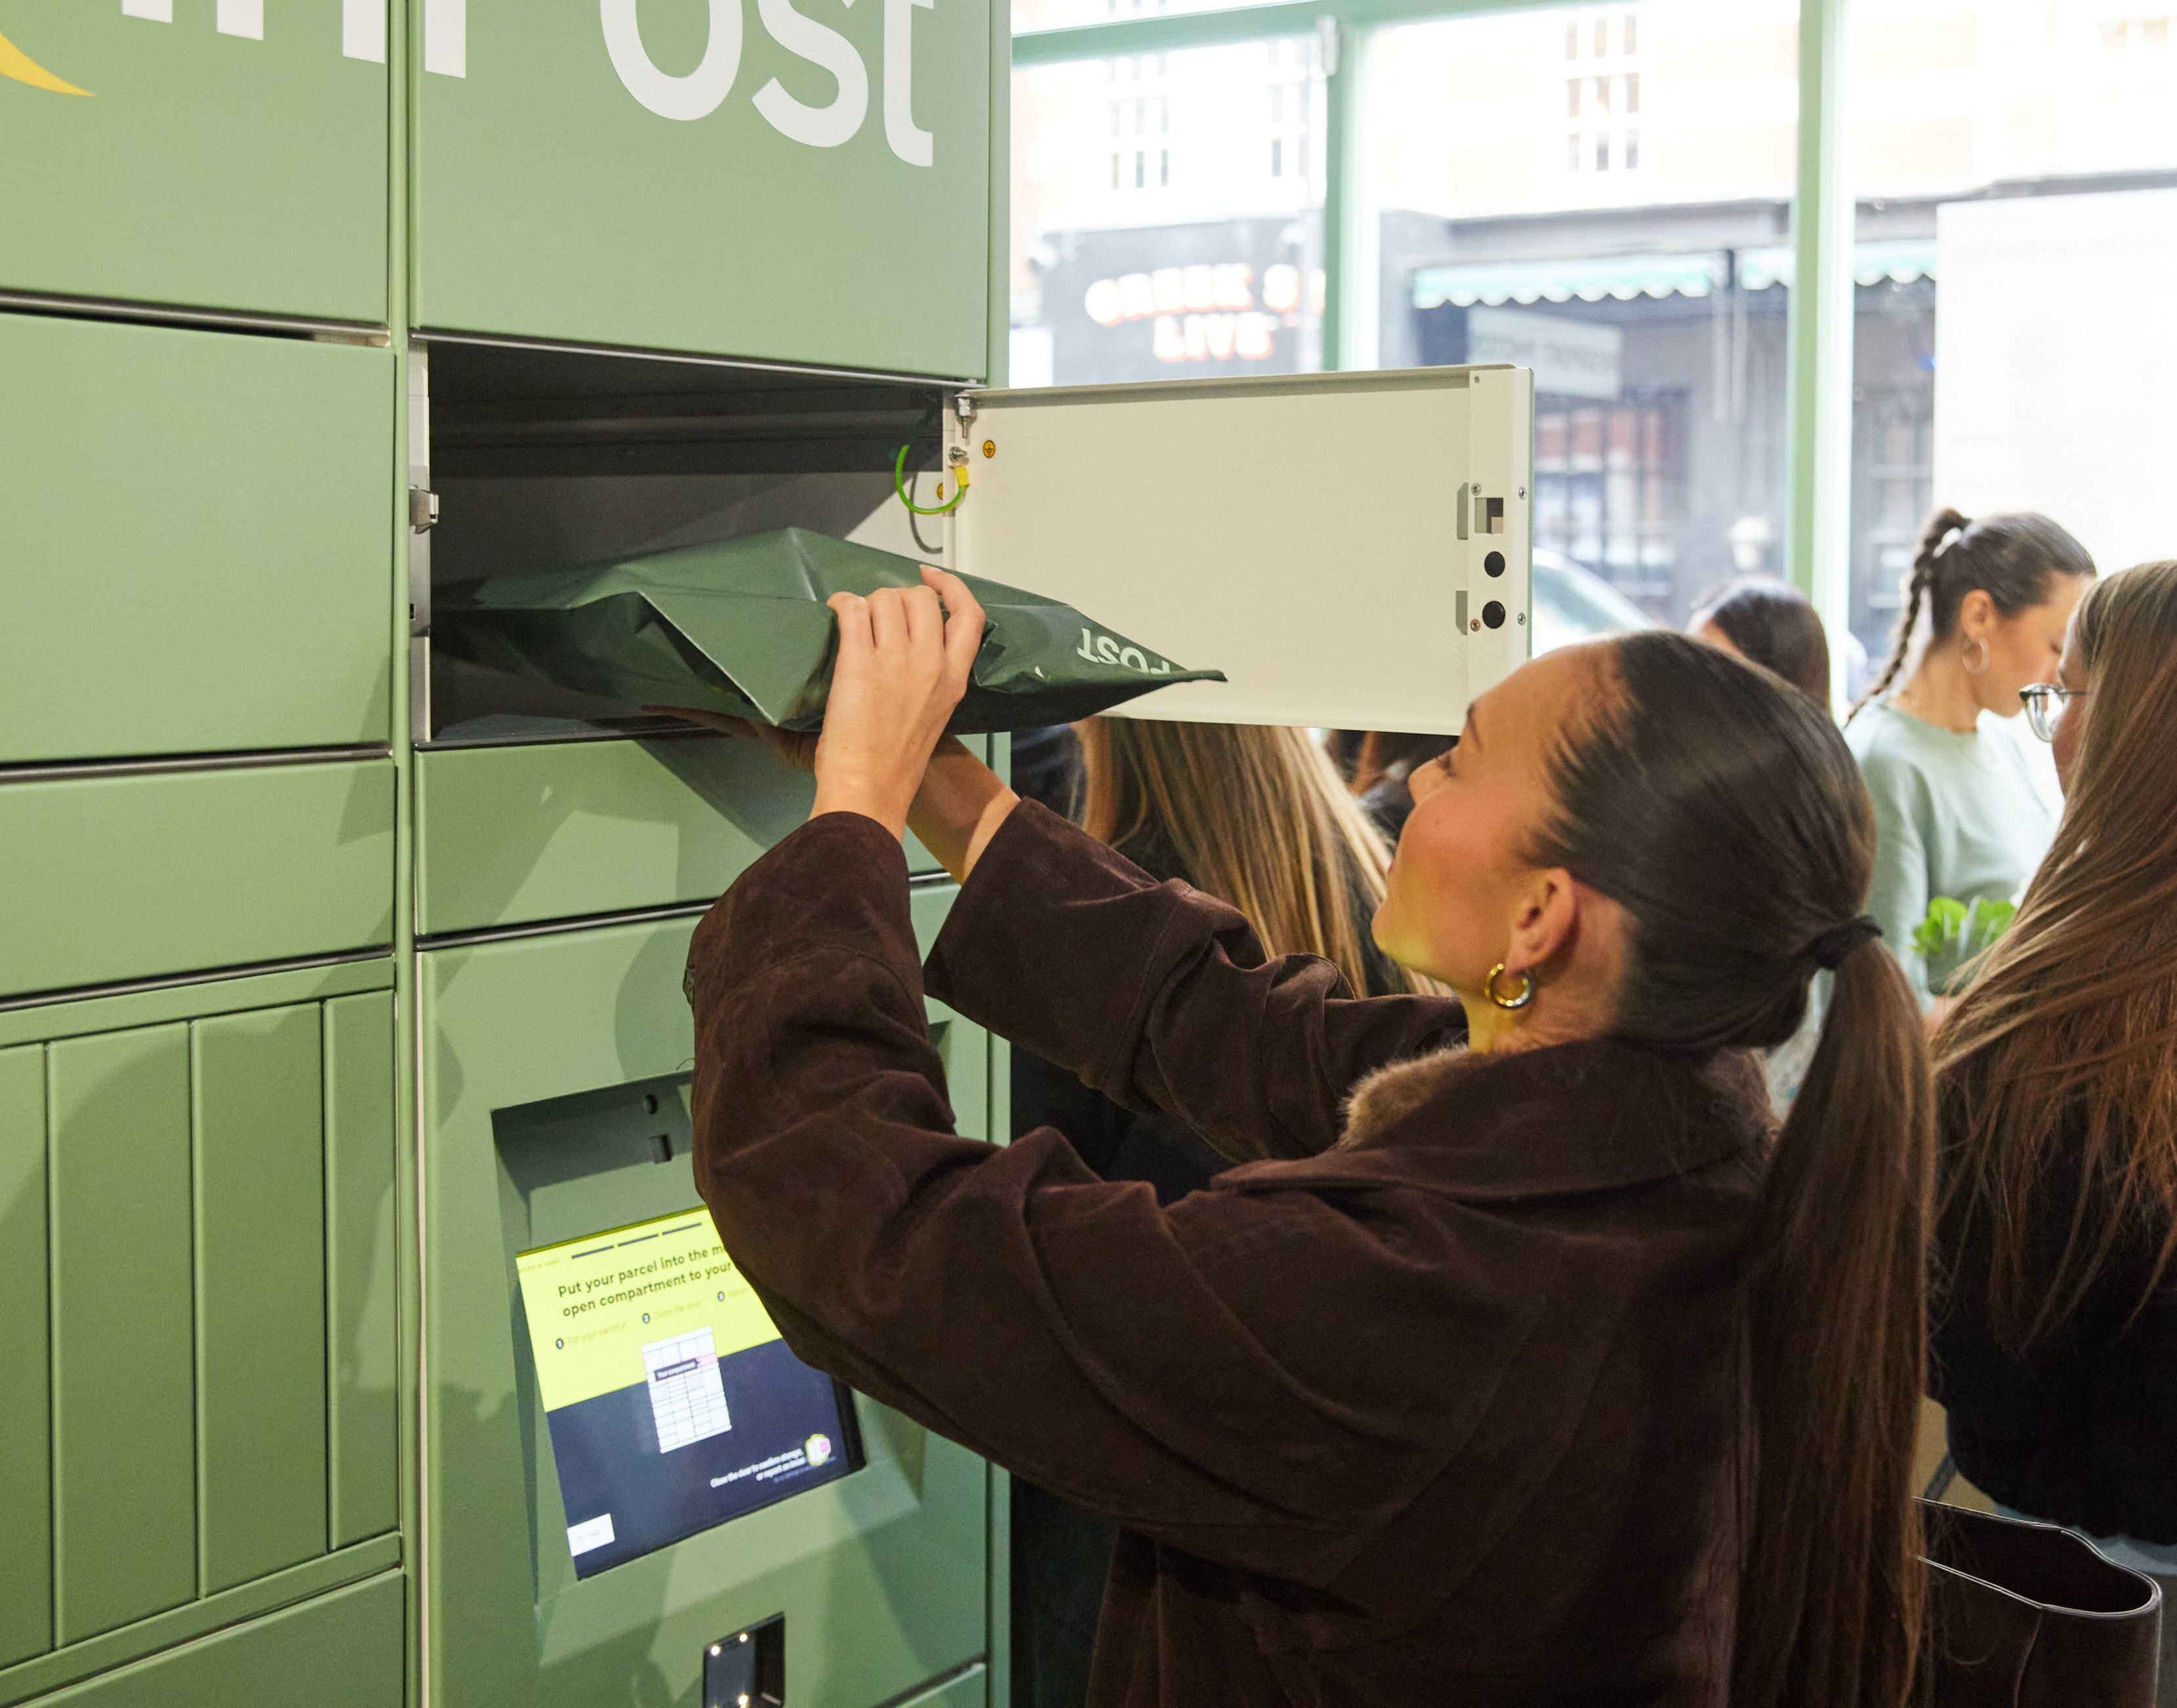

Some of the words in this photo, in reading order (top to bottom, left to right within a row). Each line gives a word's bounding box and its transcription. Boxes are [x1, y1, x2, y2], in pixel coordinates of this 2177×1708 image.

[558, 1282, 582, 1297] Put
[585, 1274, 615, 1293] your
[618, 1260, 657, 1284] parcel
[660, 1254, 685, 1270] into
[688, 1250, 708, 1262] the
[563, 1299, 596, 1318] open
[600, 1273, 687, 1307] compartment
[689, 1269, 702, 1282] to
[704, 1262, 731, 1280] your
